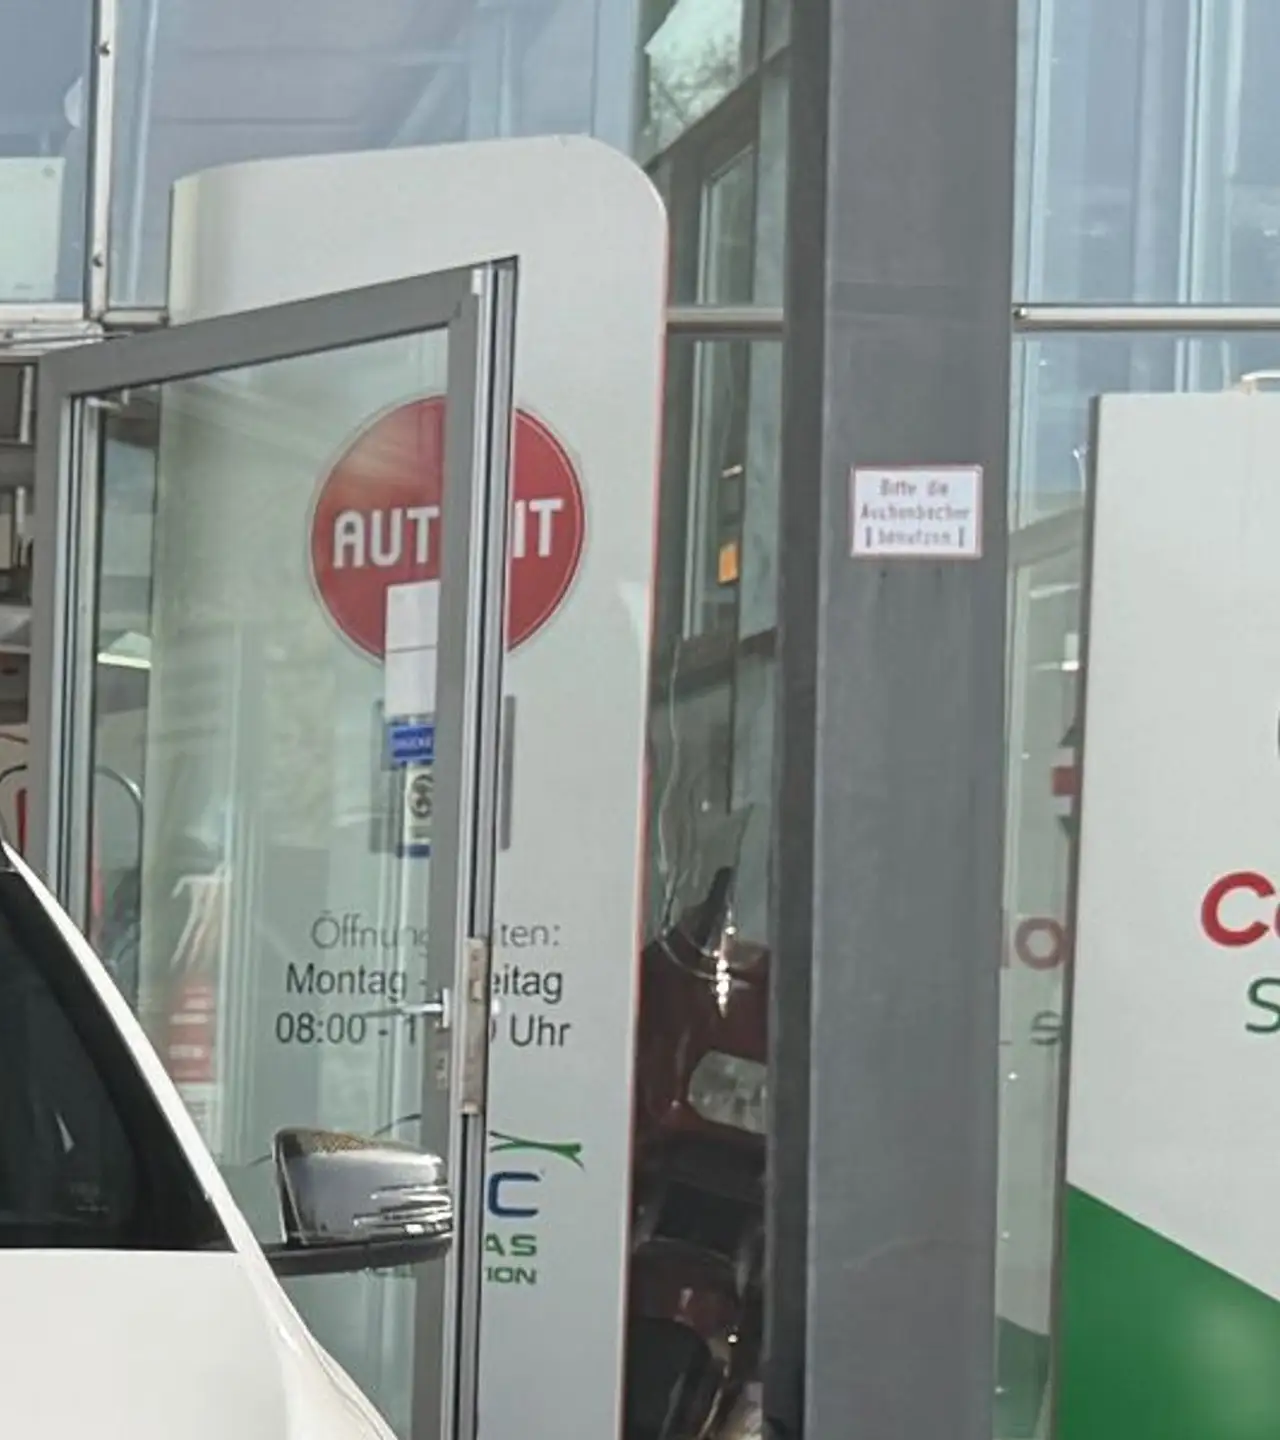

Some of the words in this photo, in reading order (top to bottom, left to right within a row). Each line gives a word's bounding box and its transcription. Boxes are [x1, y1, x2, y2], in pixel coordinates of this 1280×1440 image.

[333, 499, 564, 569] AUTIT
[1200, 871, 1280, 949] C
[287, 962, 407, 1004] Montag
[276, 1012, 366, 1044] 08:00
[511, 1013, 571, 1047] Uhr
